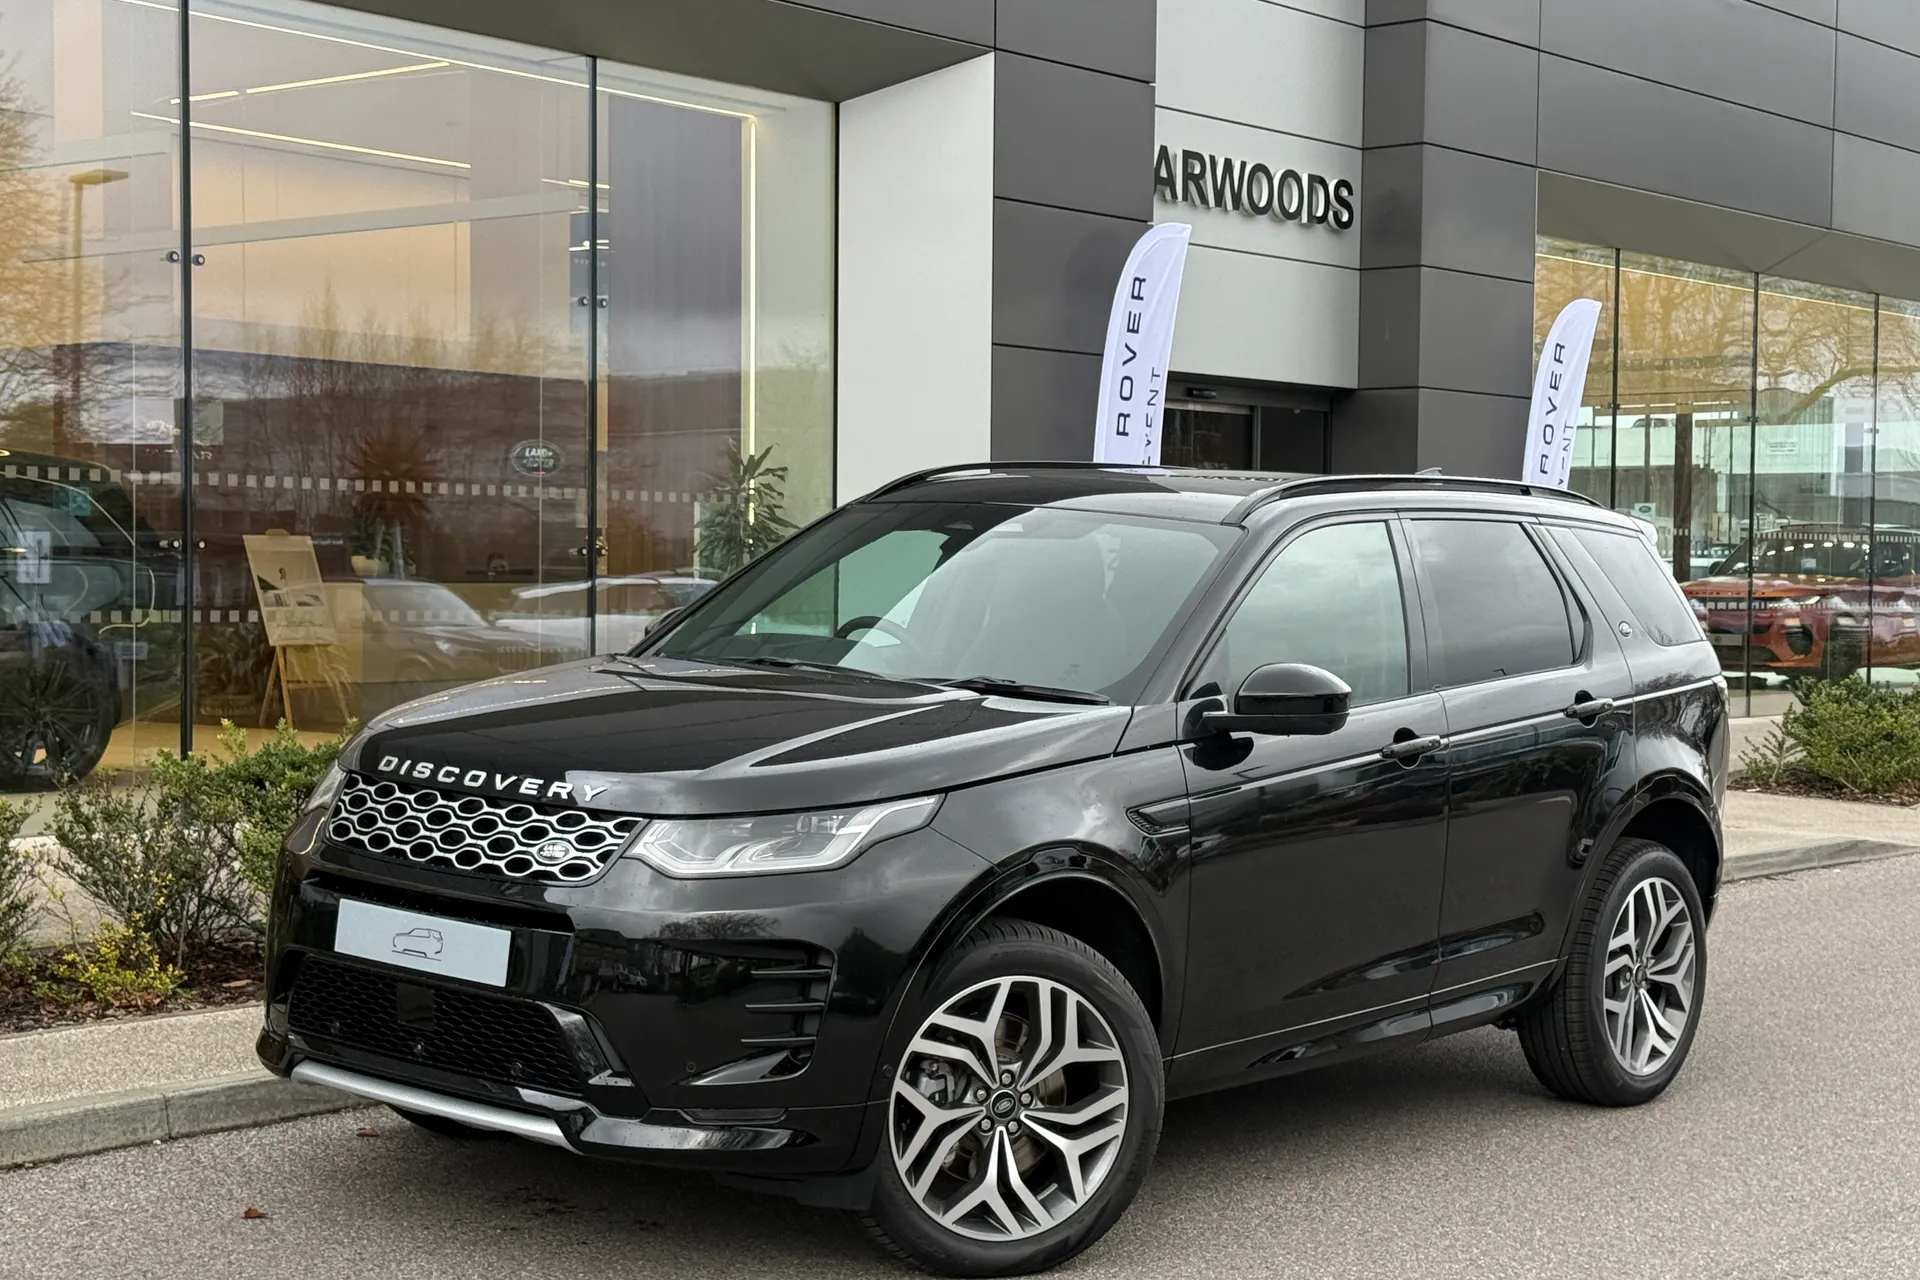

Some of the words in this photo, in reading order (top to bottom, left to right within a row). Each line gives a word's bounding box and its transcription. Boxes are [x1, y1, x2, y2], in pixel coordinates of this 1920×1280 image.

[1116, 275, 1147, 437] ROVER
[1539, 342, 1566, 475] ROVER
[377, 755, 608, 802] DISCOVERY
